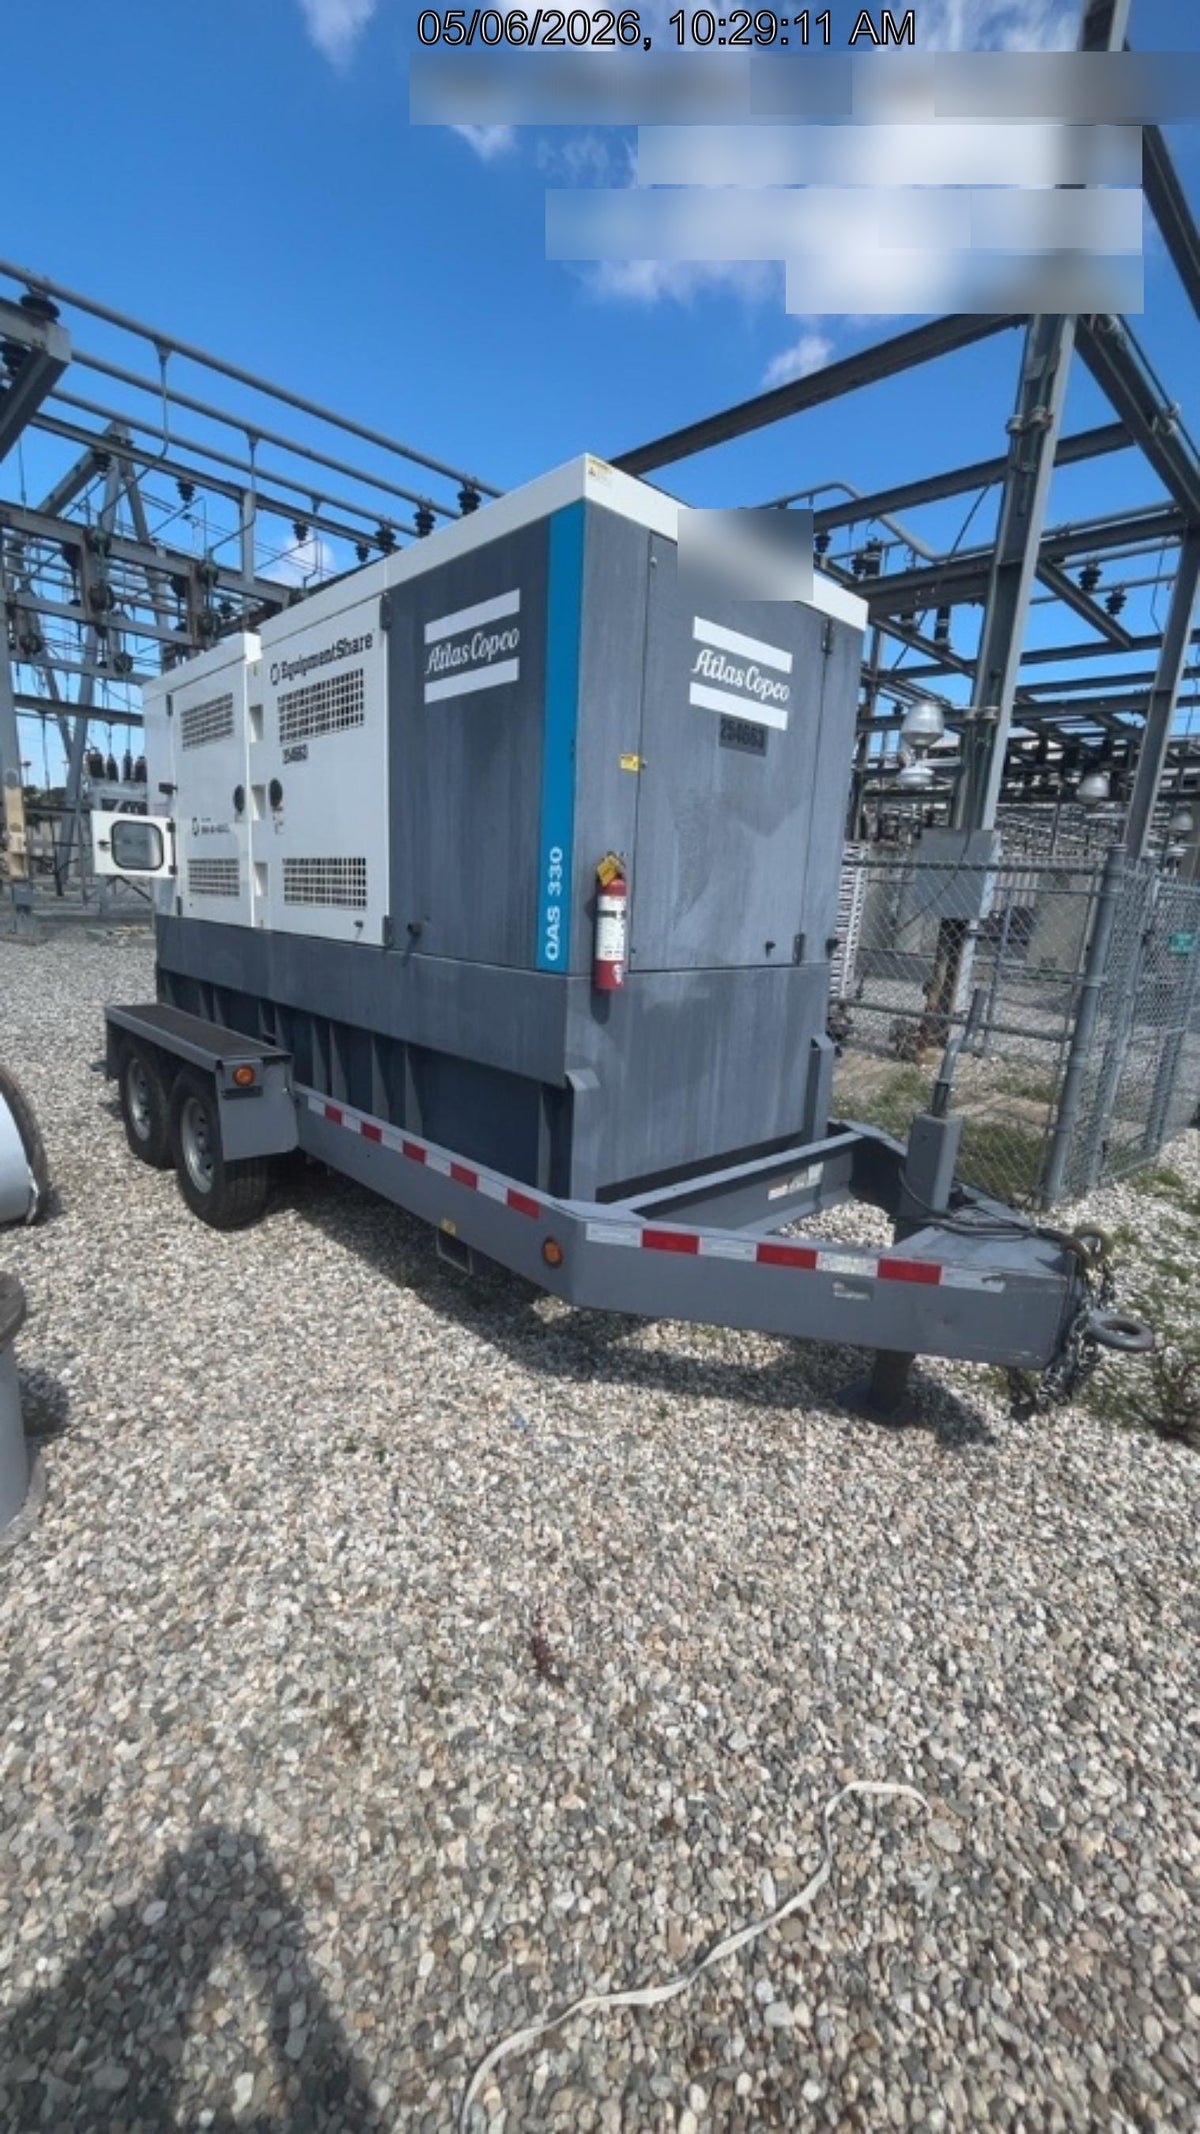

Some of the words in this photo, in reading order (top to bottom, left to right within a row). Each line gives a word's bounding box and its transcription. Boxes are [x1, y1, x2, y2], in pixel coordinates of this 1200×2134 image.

[281, 632, 373, 681] EquipmentShare
[424, 642, 470, 675] Atlas
[471, 627, 520, 662] Copco
[691, 648, 745, 688] Atlas
[745, 665, 790, 701] Copco
[547, 846, 563, 897] 330
